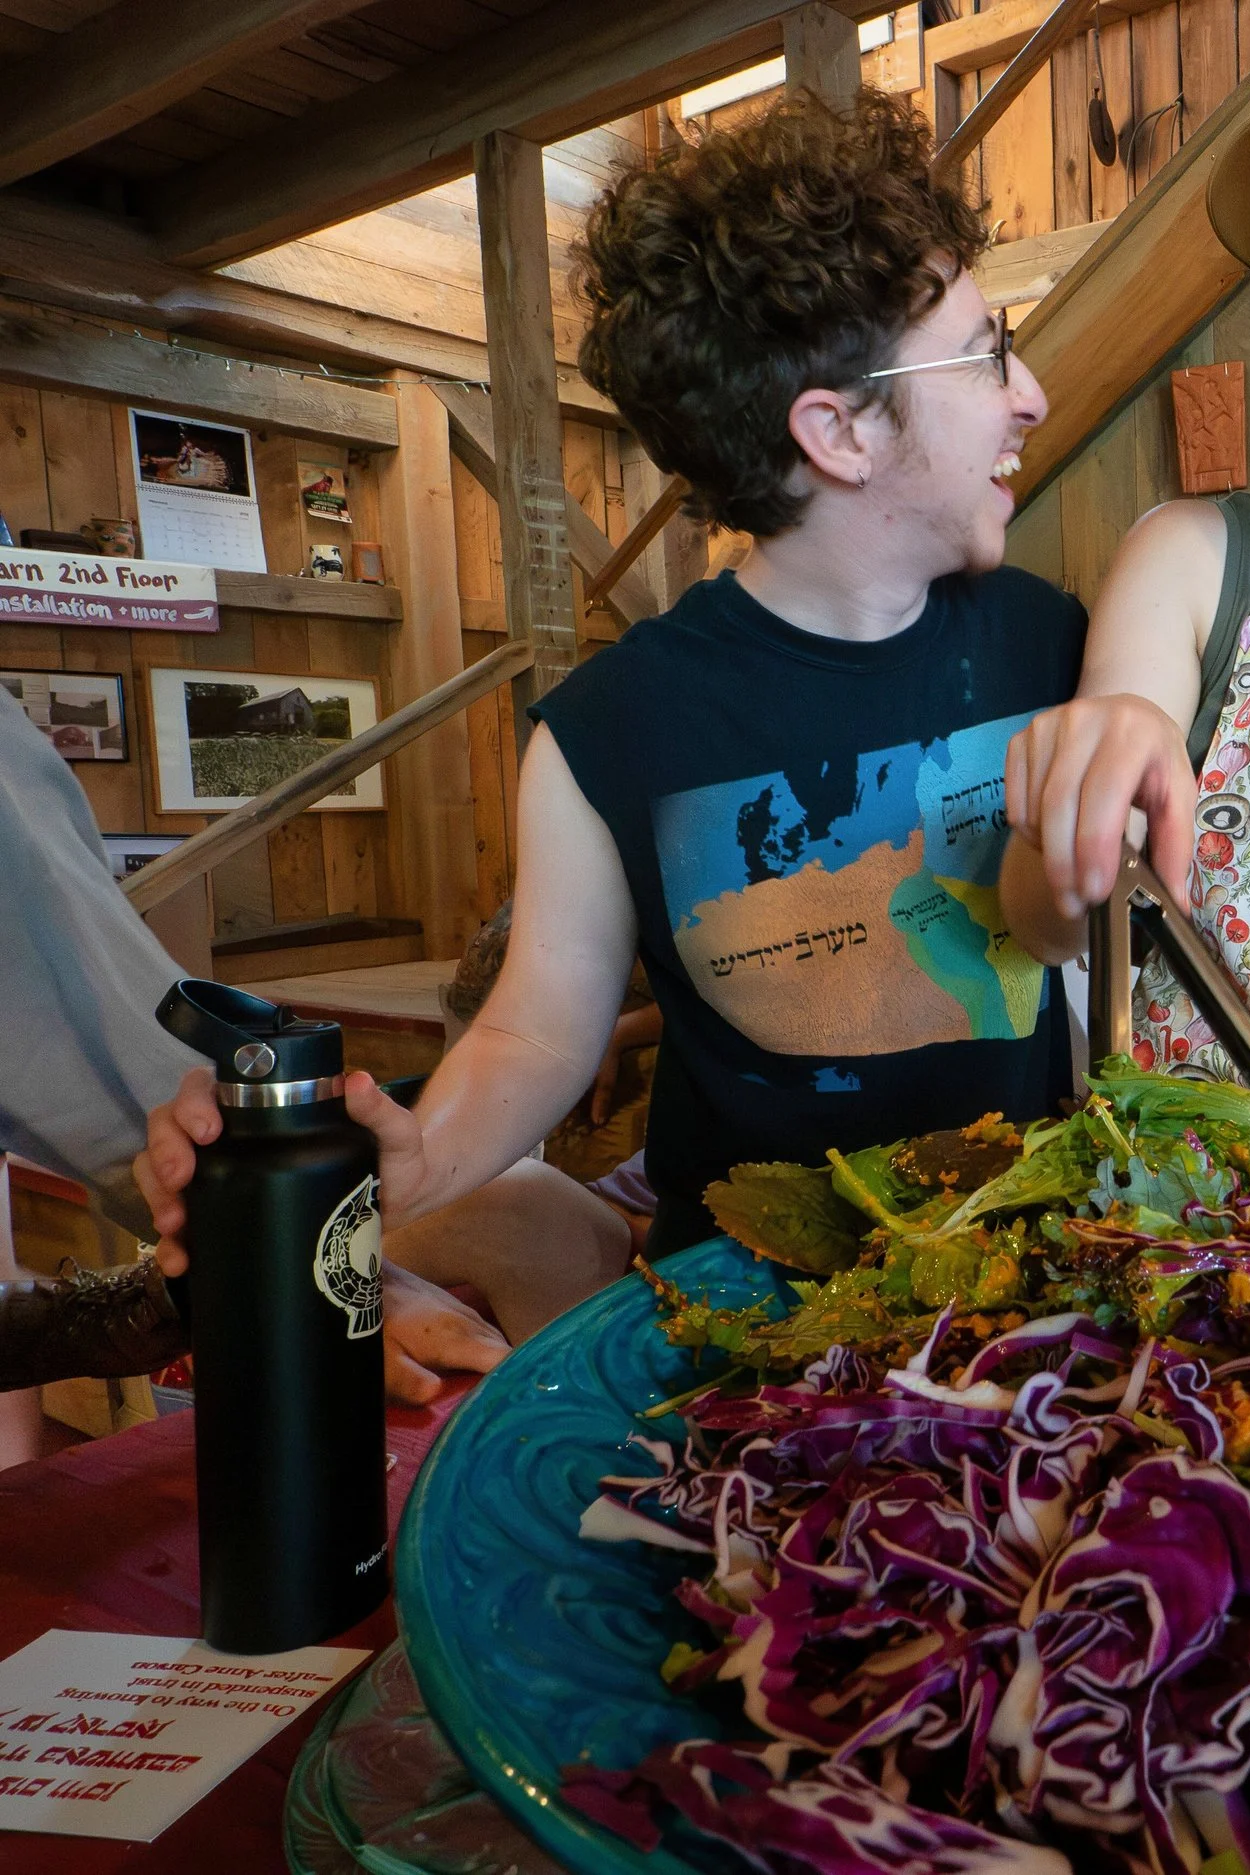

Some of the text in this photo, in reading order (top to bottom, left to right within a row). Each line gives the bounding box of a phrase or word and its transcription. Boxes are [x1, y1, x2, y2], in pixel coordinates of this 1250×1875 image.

[59, 561, 109, 585] 2nd
[116, 566, 178, 592] Floor
[131, 605, 178, 622] more
[130, 1661, 203, 1675] Carson
[204, 1665, 264, 1680] Anne
[127, 1677, 319, 1698] suspended in trust
[55, 1688, 296, 1717] On the way to knowing
